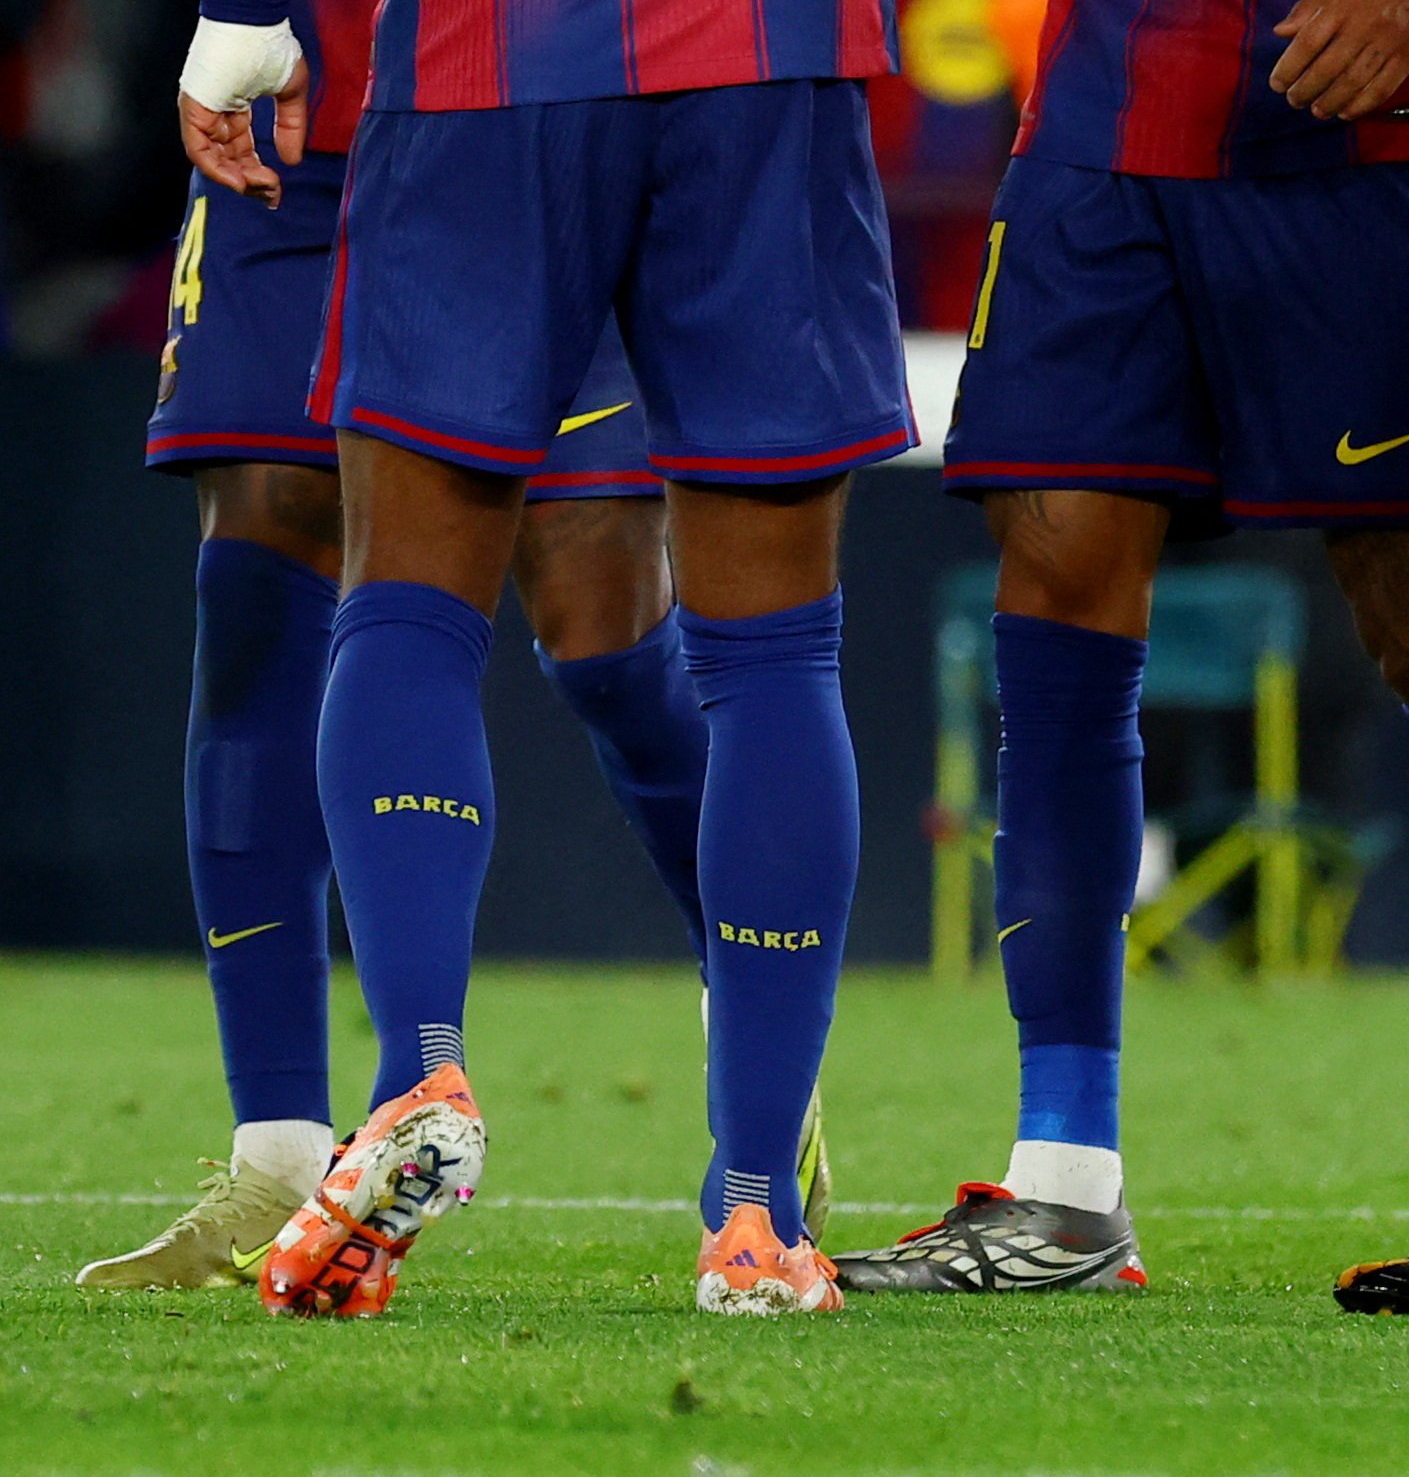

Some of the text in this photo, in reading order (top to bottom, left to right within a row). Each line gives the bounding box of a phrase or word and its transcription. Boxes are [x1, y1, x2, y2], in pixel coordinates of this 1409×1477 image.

[167, 195, 208, 326] 4
[373, 794, 481, 827] BARÇA
[718, 921, 821, 952] BARÇA
